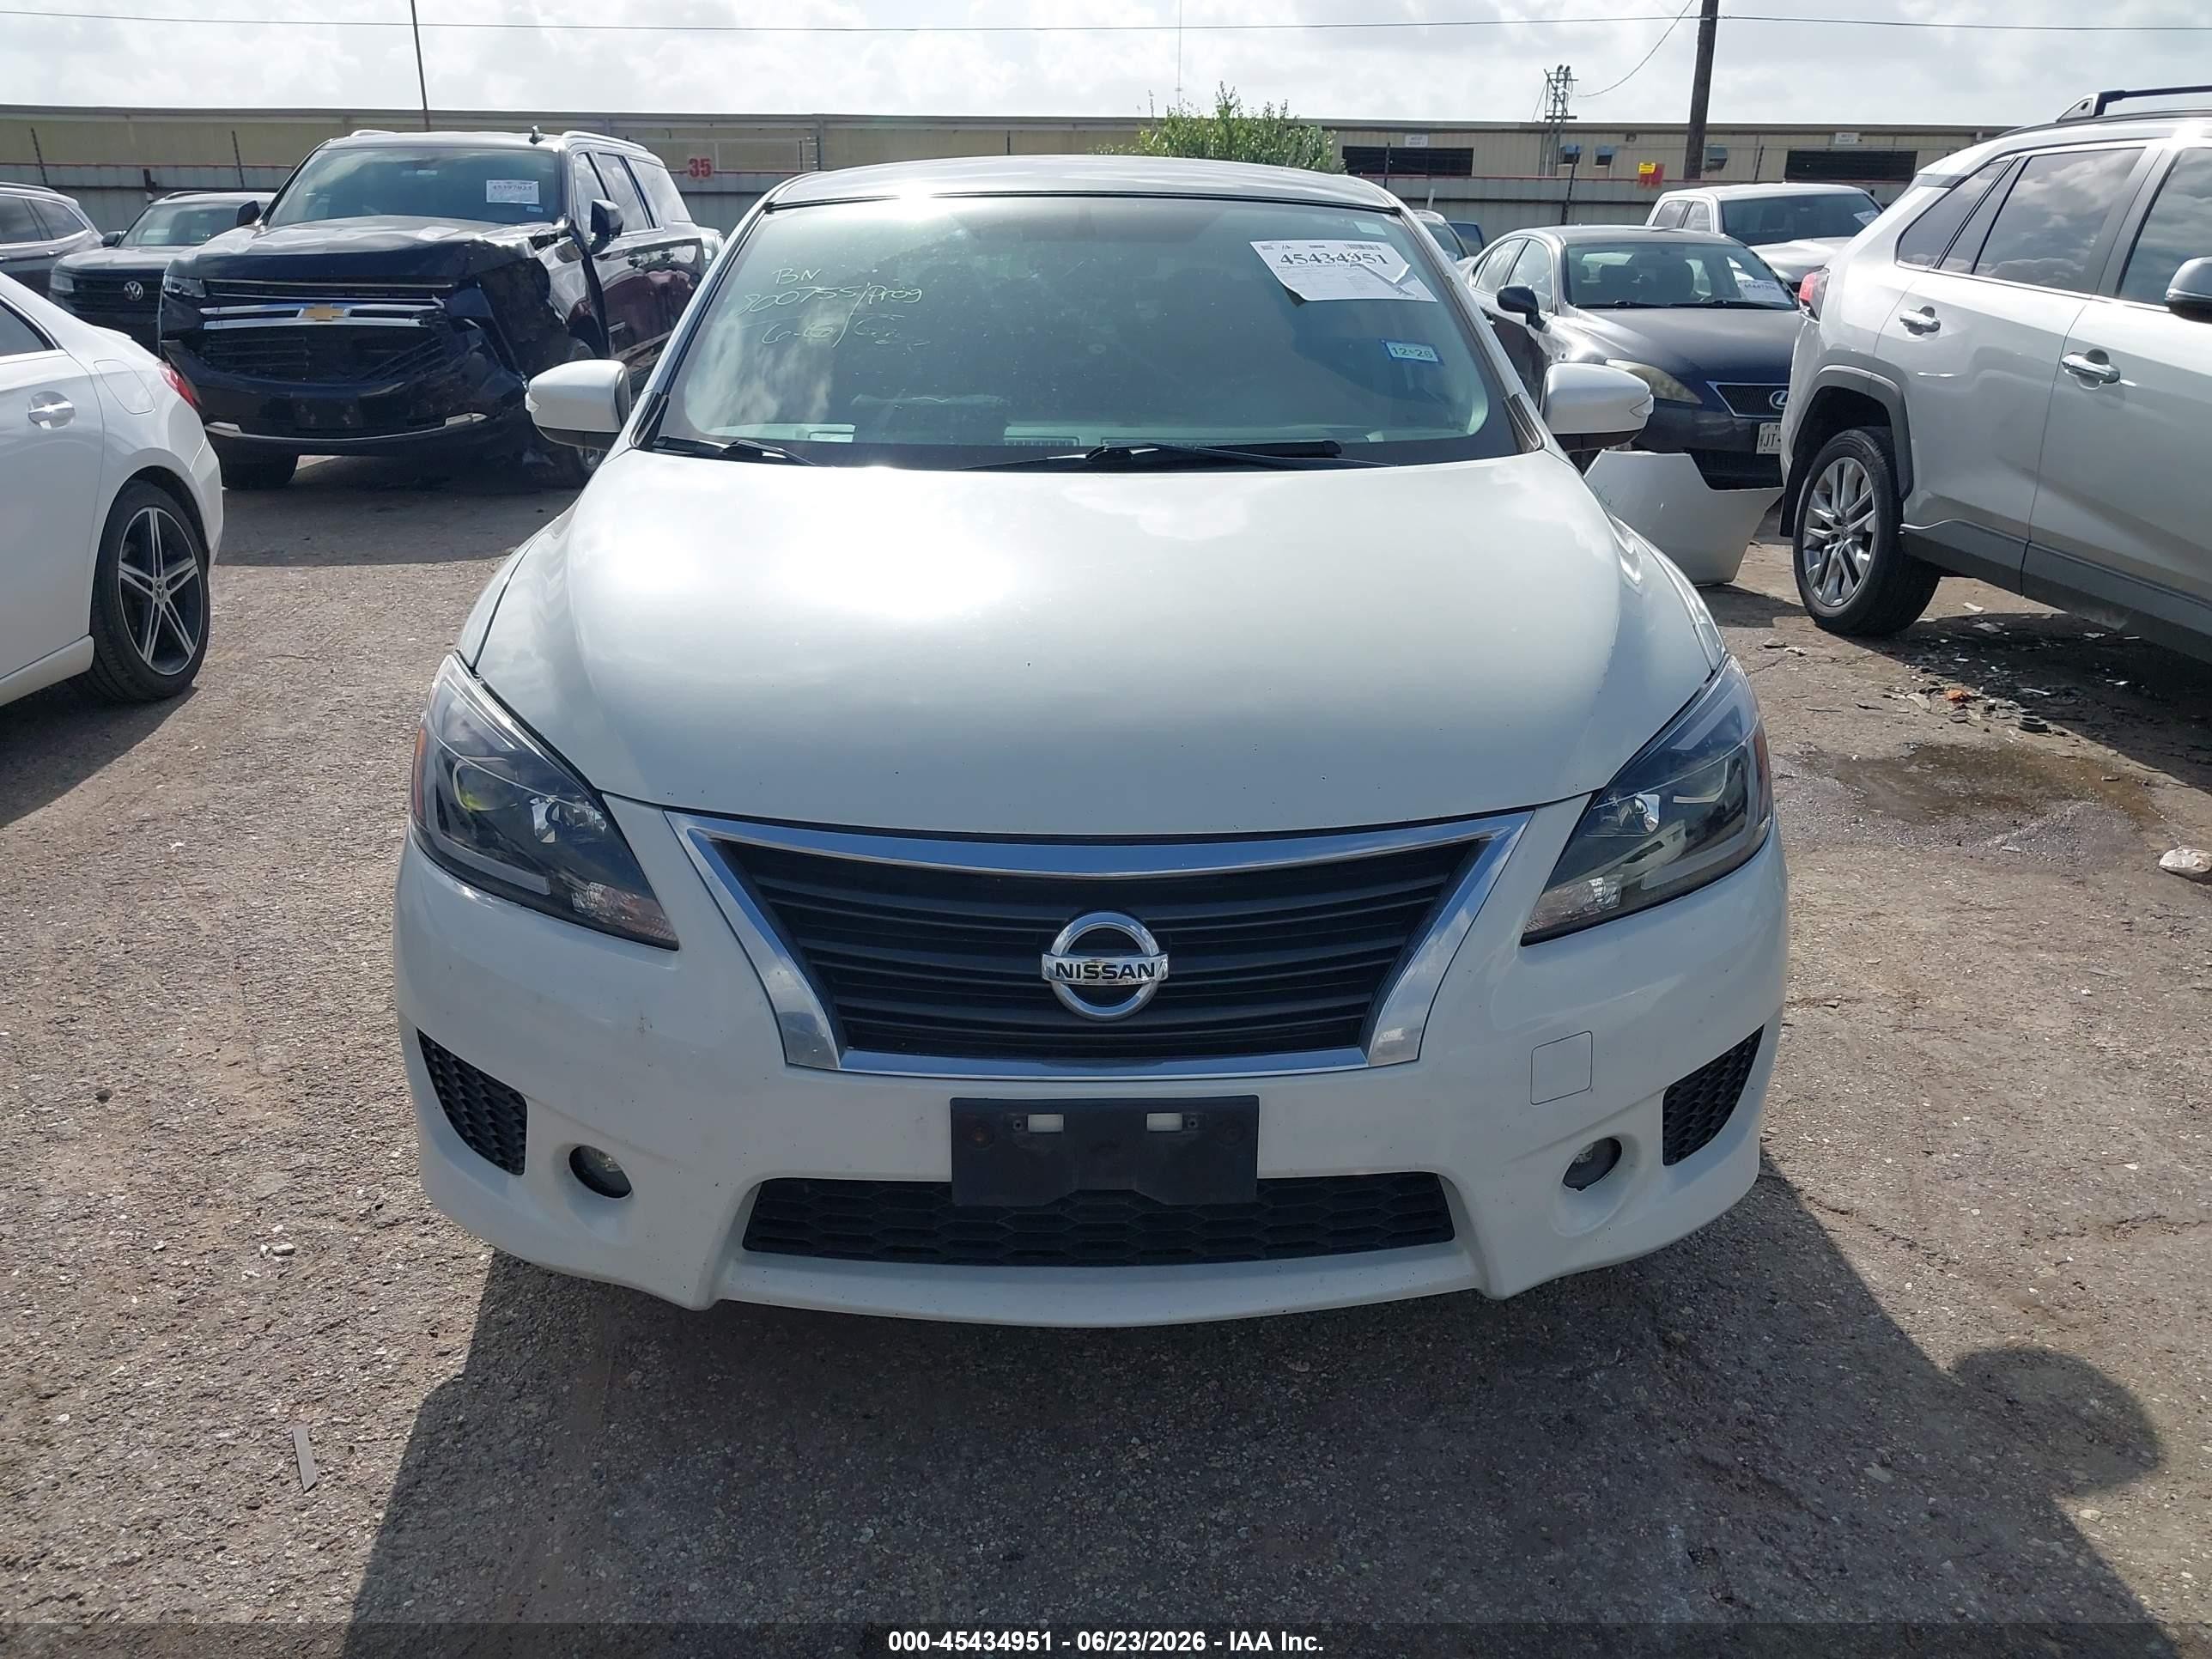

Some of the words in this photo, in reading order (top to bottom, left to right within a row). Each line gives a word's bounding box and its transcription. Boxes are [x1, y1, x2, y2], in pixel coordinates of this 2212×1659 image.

[689, 158, 712, 178] 35
[1280, 252, 1389, 264] 45434951
[771, 268, 822, 284] BN
[1055, 962, 1155, 979] NISSAN
